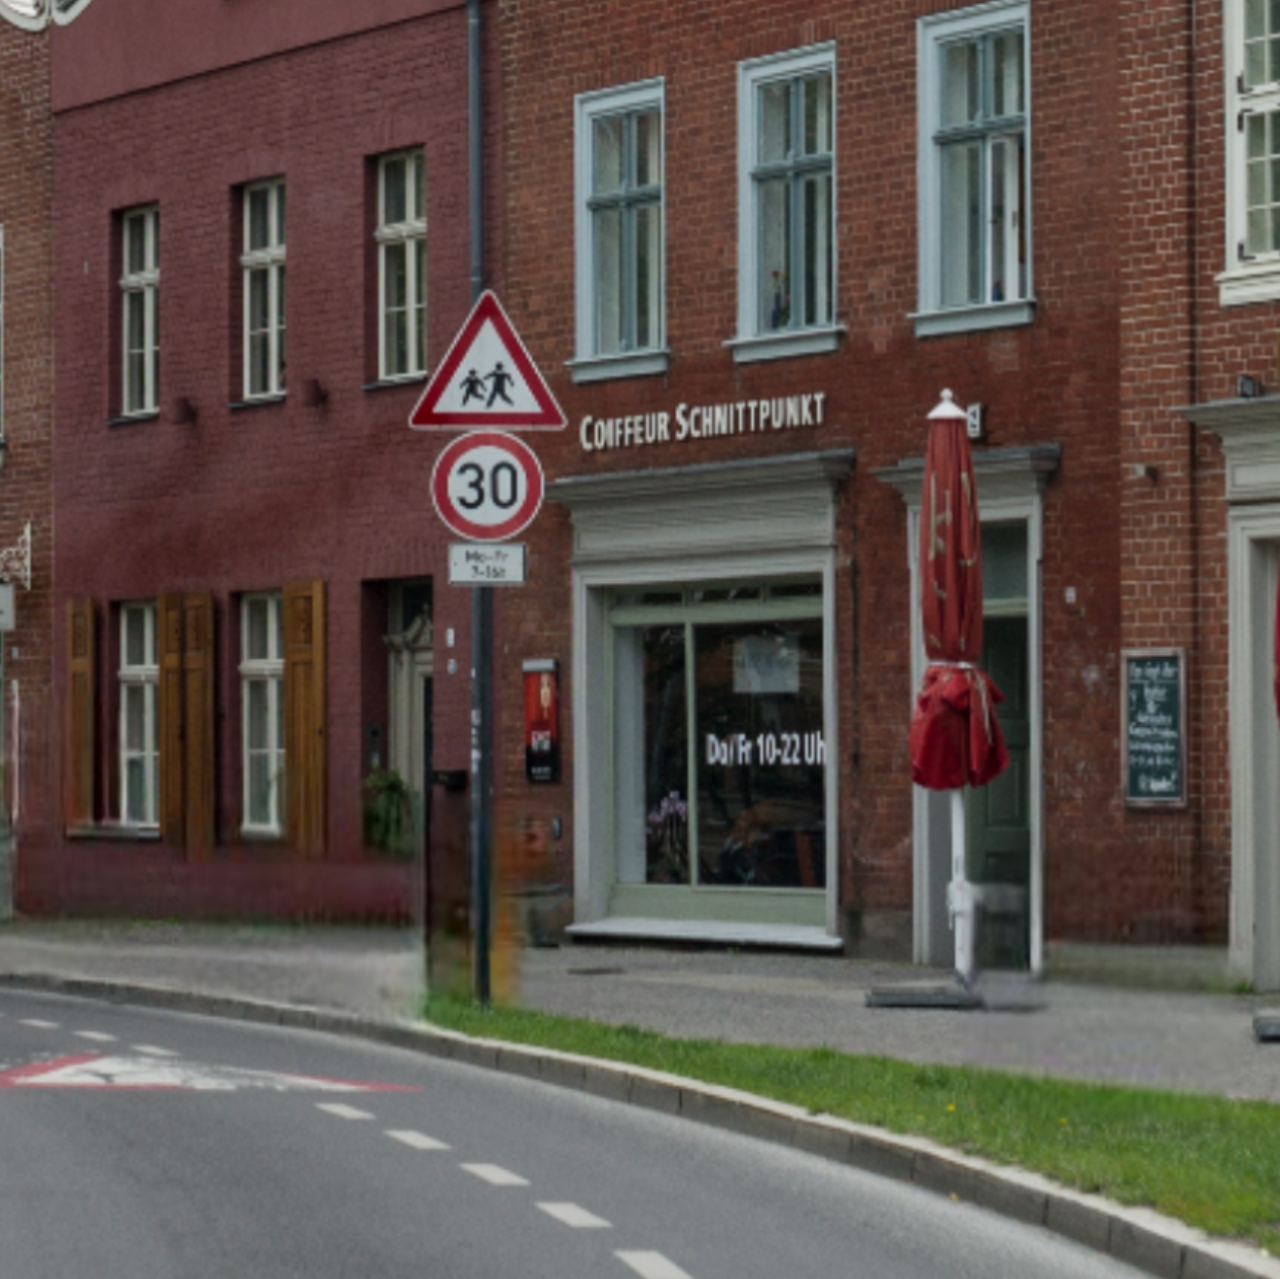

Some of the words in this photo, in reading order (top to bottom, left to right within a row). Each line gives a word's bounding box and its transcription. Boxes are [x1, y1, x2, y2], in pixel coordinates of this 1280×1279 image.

[675, 392, 825, 441] SCHNITTPUNKT
[457, 461, 518, 510] 30
[804, 730, 827, 765] Uh
